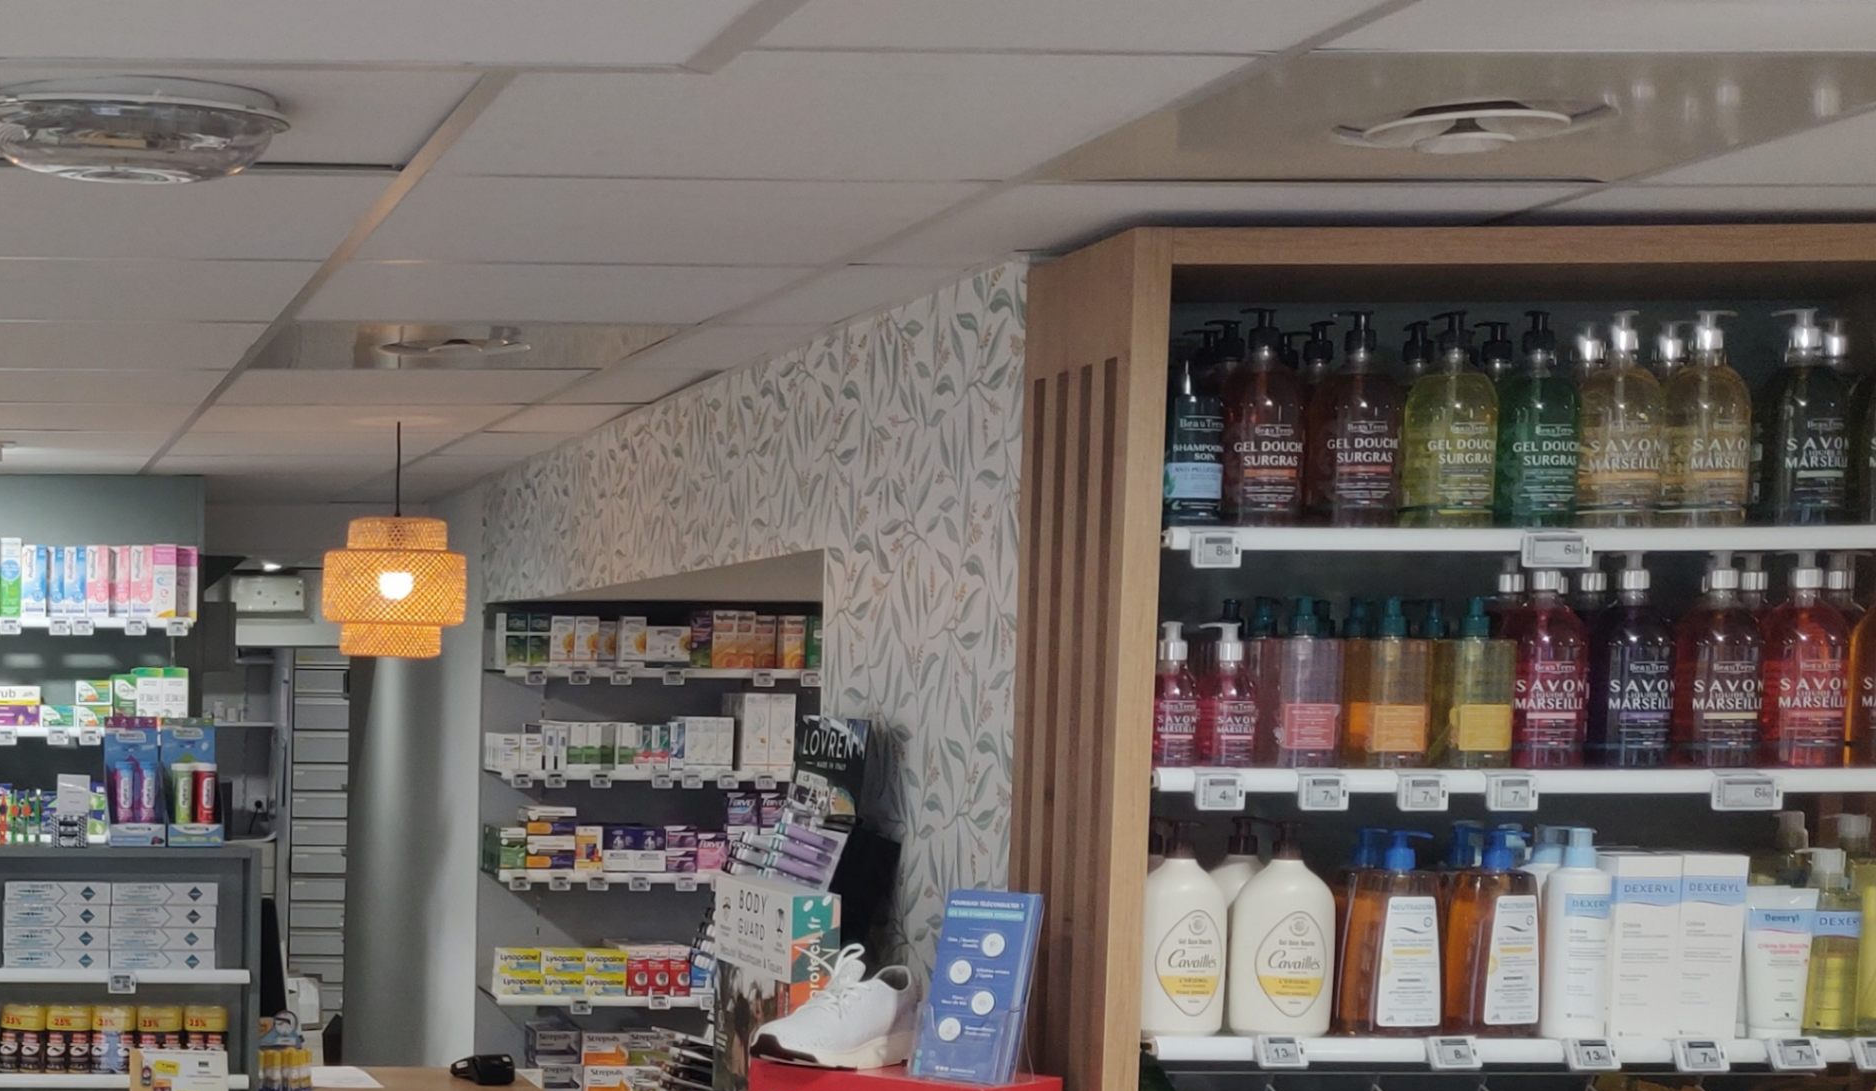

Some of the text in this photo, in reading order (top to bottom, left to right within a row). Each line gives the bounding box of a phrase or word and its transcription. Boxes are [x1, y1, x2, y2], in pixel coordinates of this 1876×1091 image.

[1234, 442, 1259, 453] GEL
[1327, 438, 1350, 449] GEL
[1428, 439, 1450, 451] GEL
[1513, 441, 1538, 453] GEL
[1244, 455, 1298, 467] SURGRAS
[1337, 451, 1393, 463] SURGRAS
[1438, 452, 1492, 464] SURGRAS
[1516, 679, 1585, 692] SAVON
[802, 729, 853, 760] LOVREN
[1624, 883, 1674, 893] DEXERYL
[1689, 882, 1740, 893] DEXERYL
[739, 889, 769, 915] BODY
[738, 918, 765, 941] GUARD
